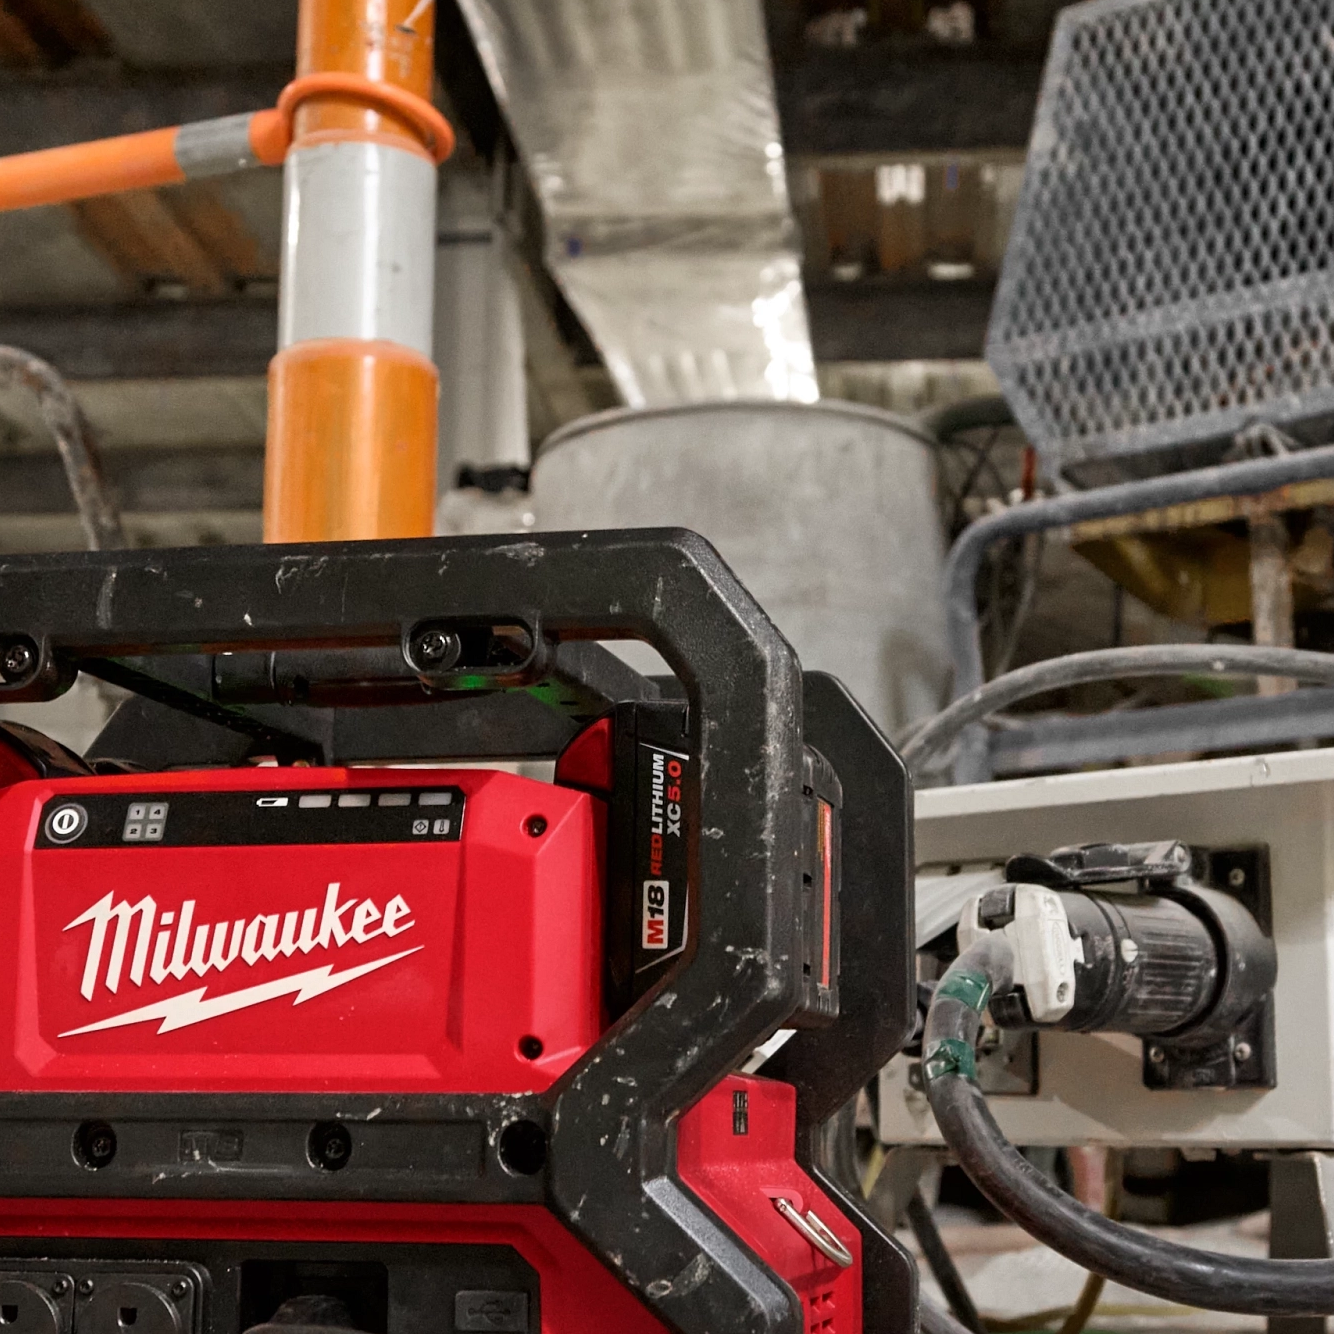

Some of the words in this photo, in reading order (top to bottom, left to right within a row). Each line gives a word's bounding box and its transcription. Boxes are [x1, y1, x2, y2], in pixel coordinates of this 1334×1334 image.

[650, 753, 665, 875] REDLITHIUM
[667, 760, 681, 837] XC5.0
[62, 882, 416, 1001] Milwaukee
[646, 884, 666, 945] M18
